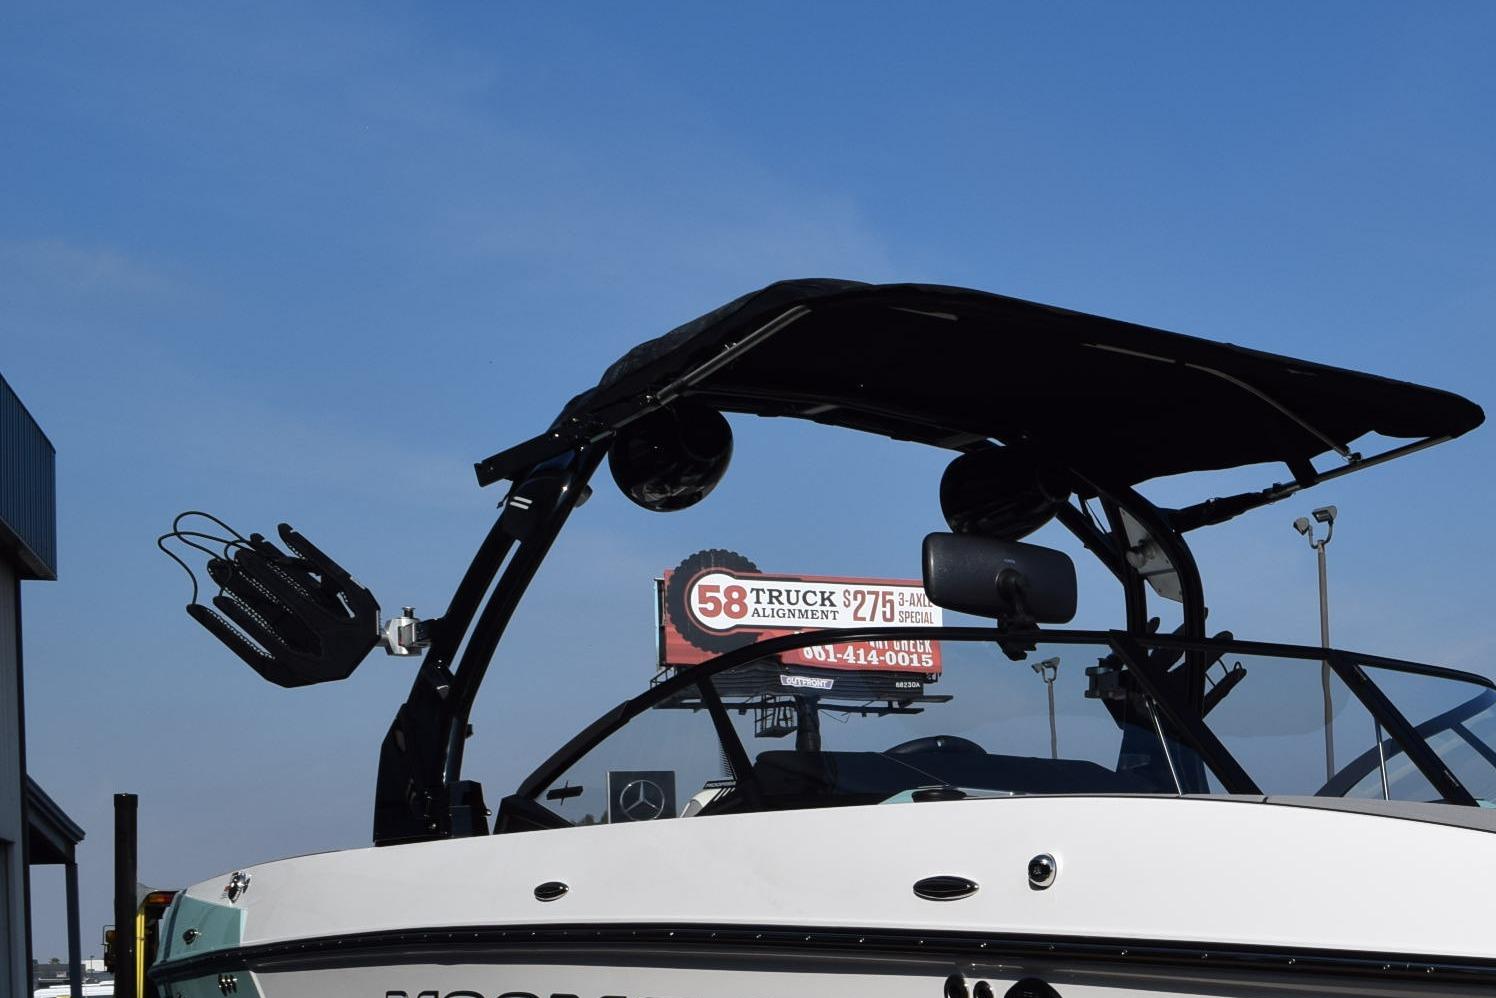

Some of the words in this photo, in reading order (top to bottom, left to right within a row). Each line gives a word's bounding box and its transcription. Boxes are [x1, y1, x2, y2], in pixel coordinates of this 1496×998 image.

[697, 584, 748, 619] 58
[750, 587, 837, 607] TRUCK
[751, 607, 839, 620] ALIGNMENT
[843, 589, 895, 623] $275
[898, 610, 934, 625] SPECIAL
[786, 676, 827, 688] OUTFRONT
